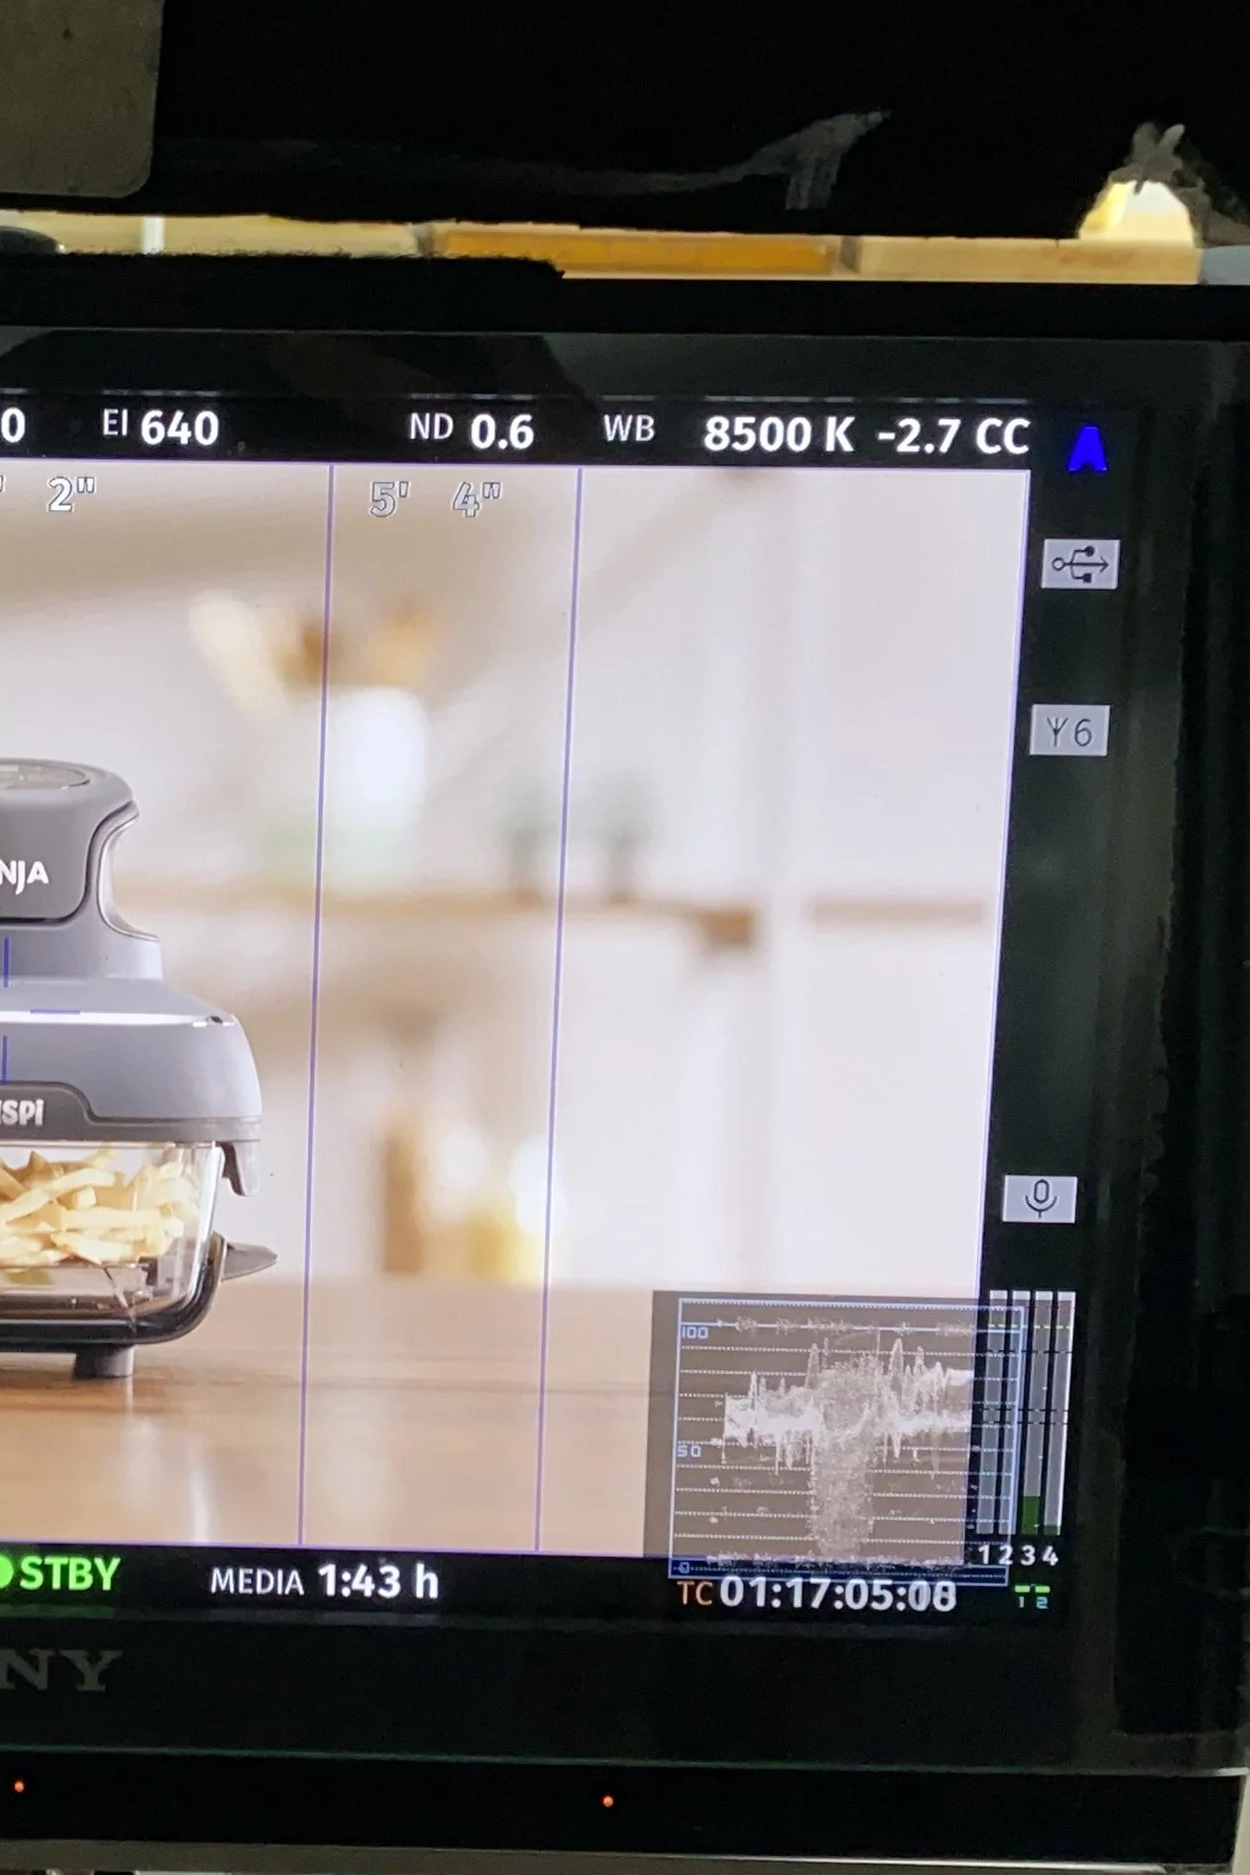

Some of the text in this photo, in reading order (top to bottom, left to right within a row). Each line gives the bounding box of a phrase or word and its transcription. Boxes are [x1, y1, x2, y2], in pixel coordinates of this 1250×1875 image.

[103, 408, 219, 447] EI 640
[410, 412, 535, 450] ND 0.6
[603, 414, 1031, 455] WB 8500 K -2.7 CC
[680, 1325, 710, 1340] 100
[676, 1443, 703, 1459] 50
[17, 1554, 121, 1591] STBY
[210, 1560, 439, 1599] MEDIA 1:43 h
[677, 1577, 713, 1606] TC
